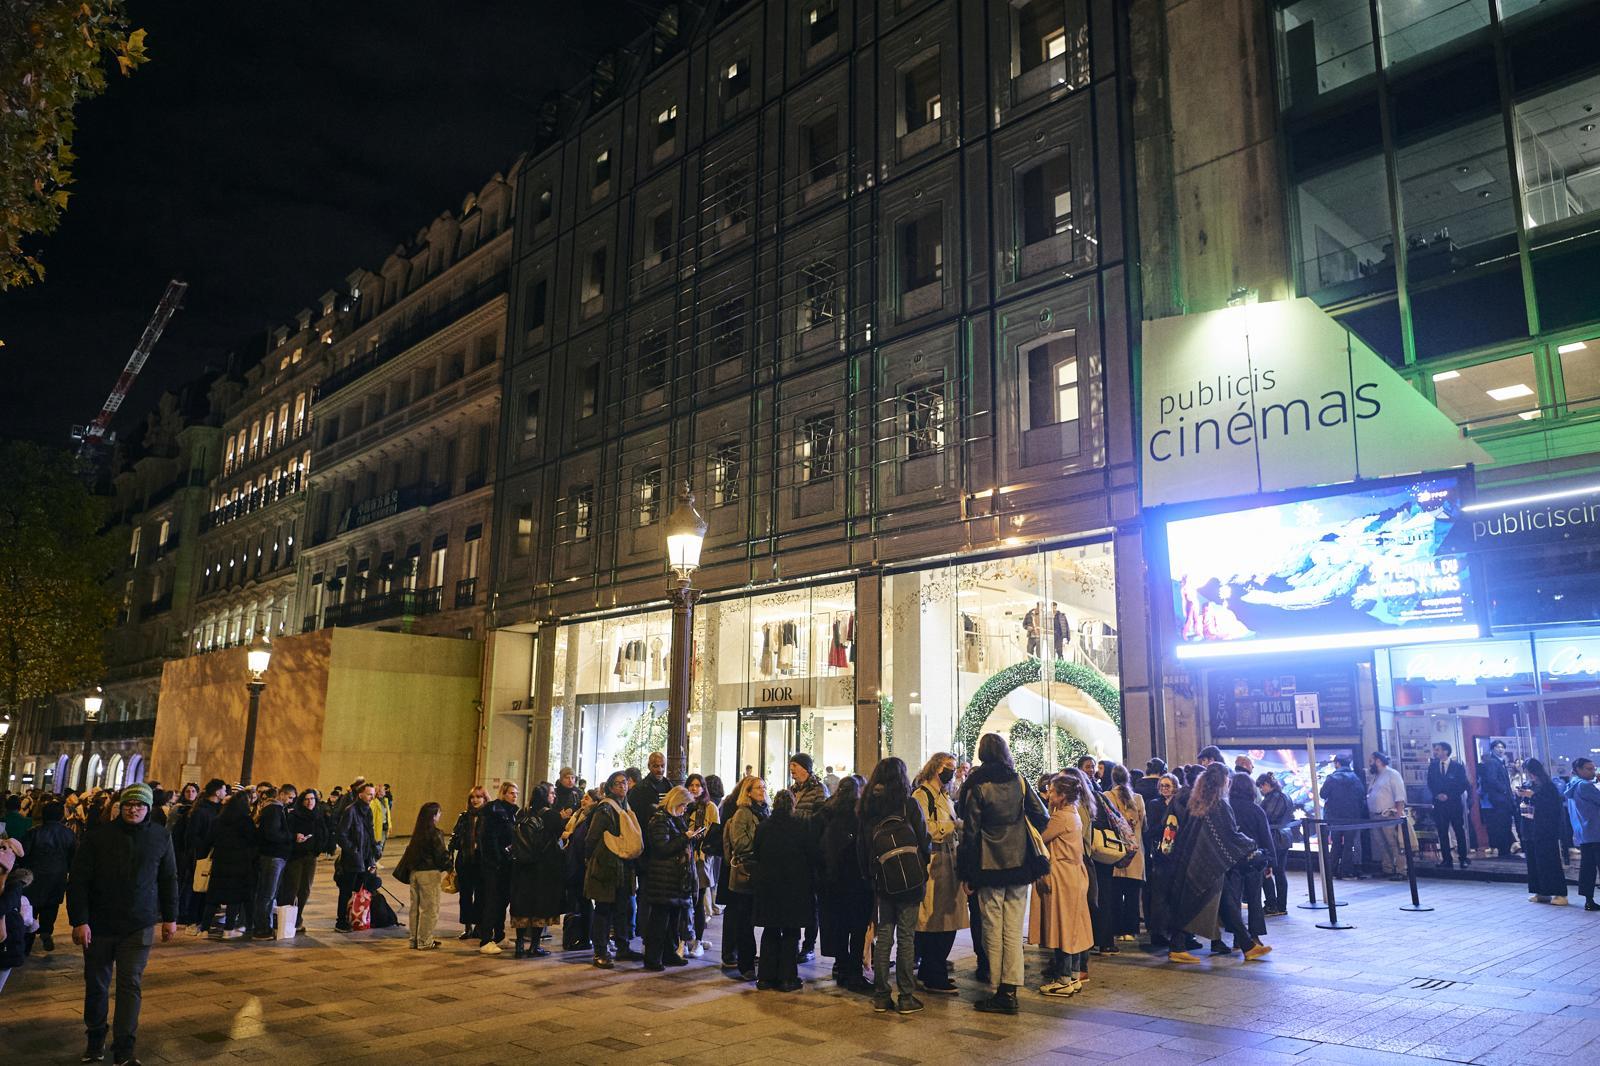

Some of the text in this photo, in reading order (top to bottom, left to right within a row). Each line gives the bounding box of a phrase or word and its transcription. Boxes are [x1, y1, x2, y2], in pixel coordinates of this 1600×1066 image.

[1149, 383, 1381, 462] cinémas
[1160, 368, 1276, 424] publicis
[762, 687, 793, 702] DIOR
